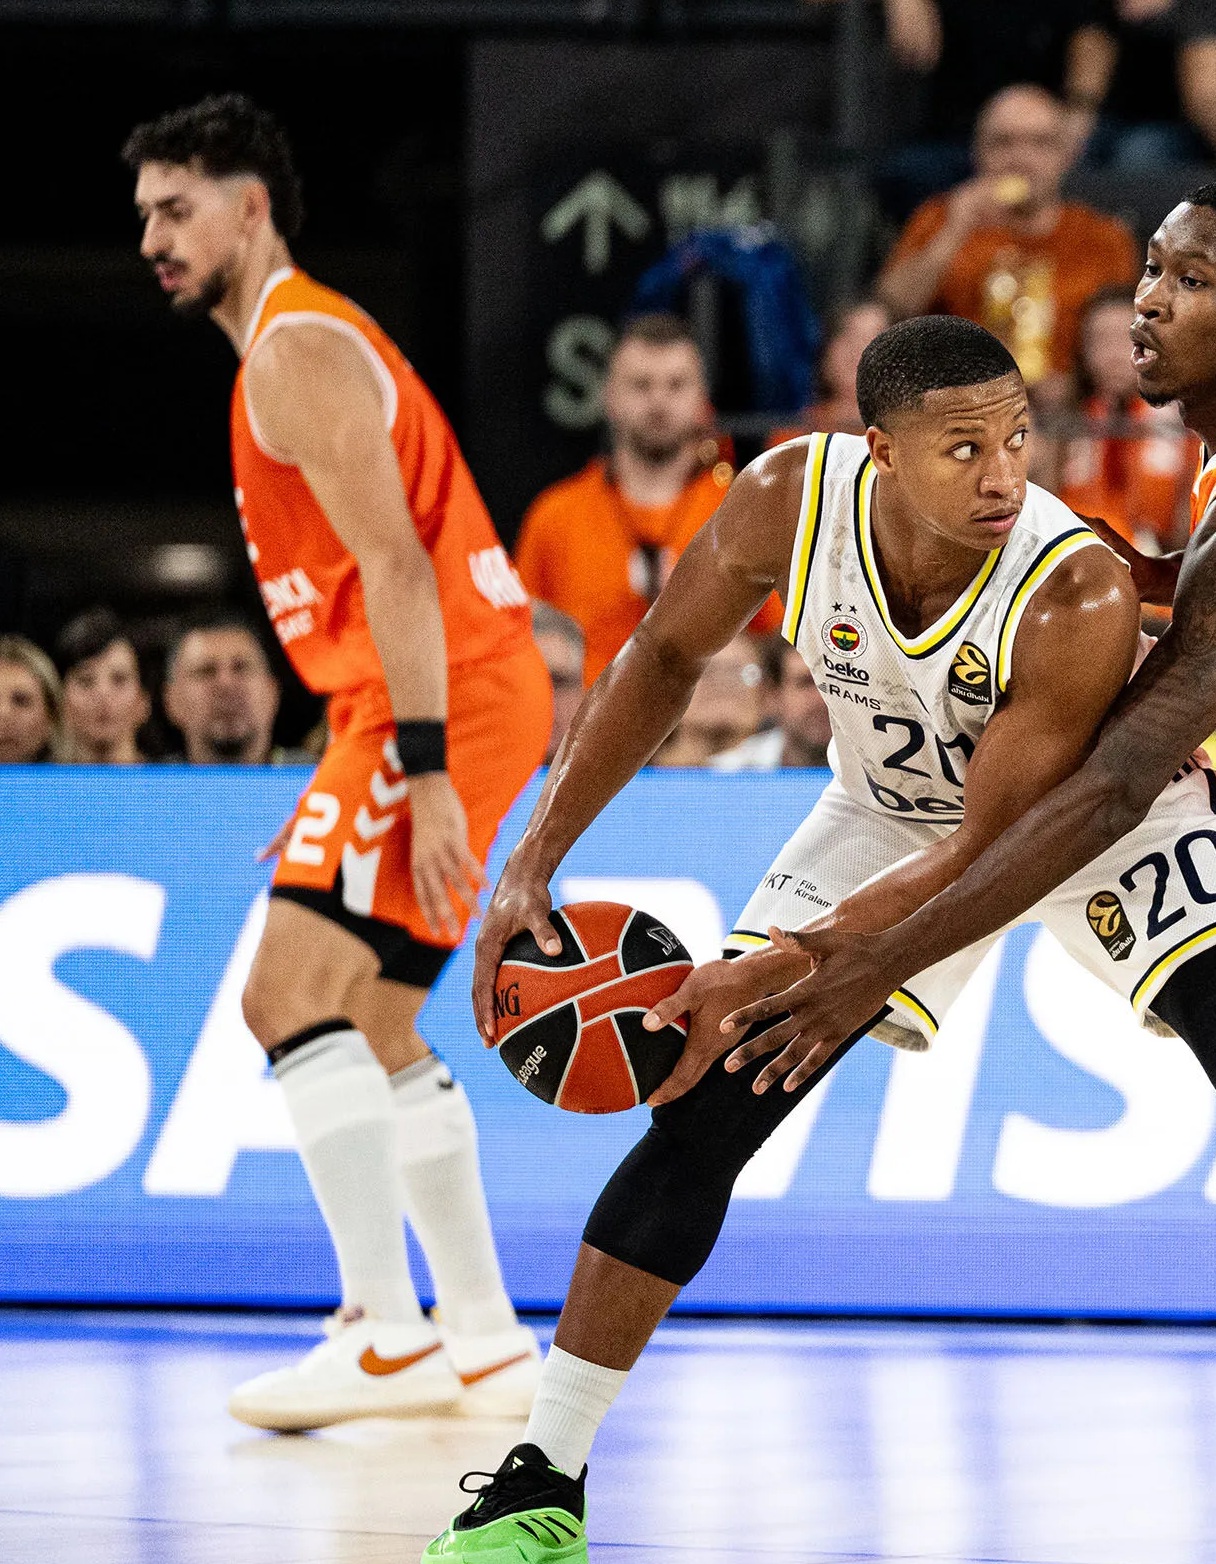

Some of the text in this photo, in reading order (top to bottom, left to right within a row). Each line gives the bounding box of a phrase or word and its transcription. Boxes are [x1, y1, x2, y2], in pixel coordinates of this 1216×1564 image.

[823, 654, 870, 682] beko
[829, 684, 882, 712] RAMS
[966, 692, 990, 703] dhabi
[861, 763, 965, 815] be
[285, 791, 341, 866] 2
[763, 872, 793, 891] KT
[799, 879, 818, 892] Filo
[517, 1044, 548, 1087] League
